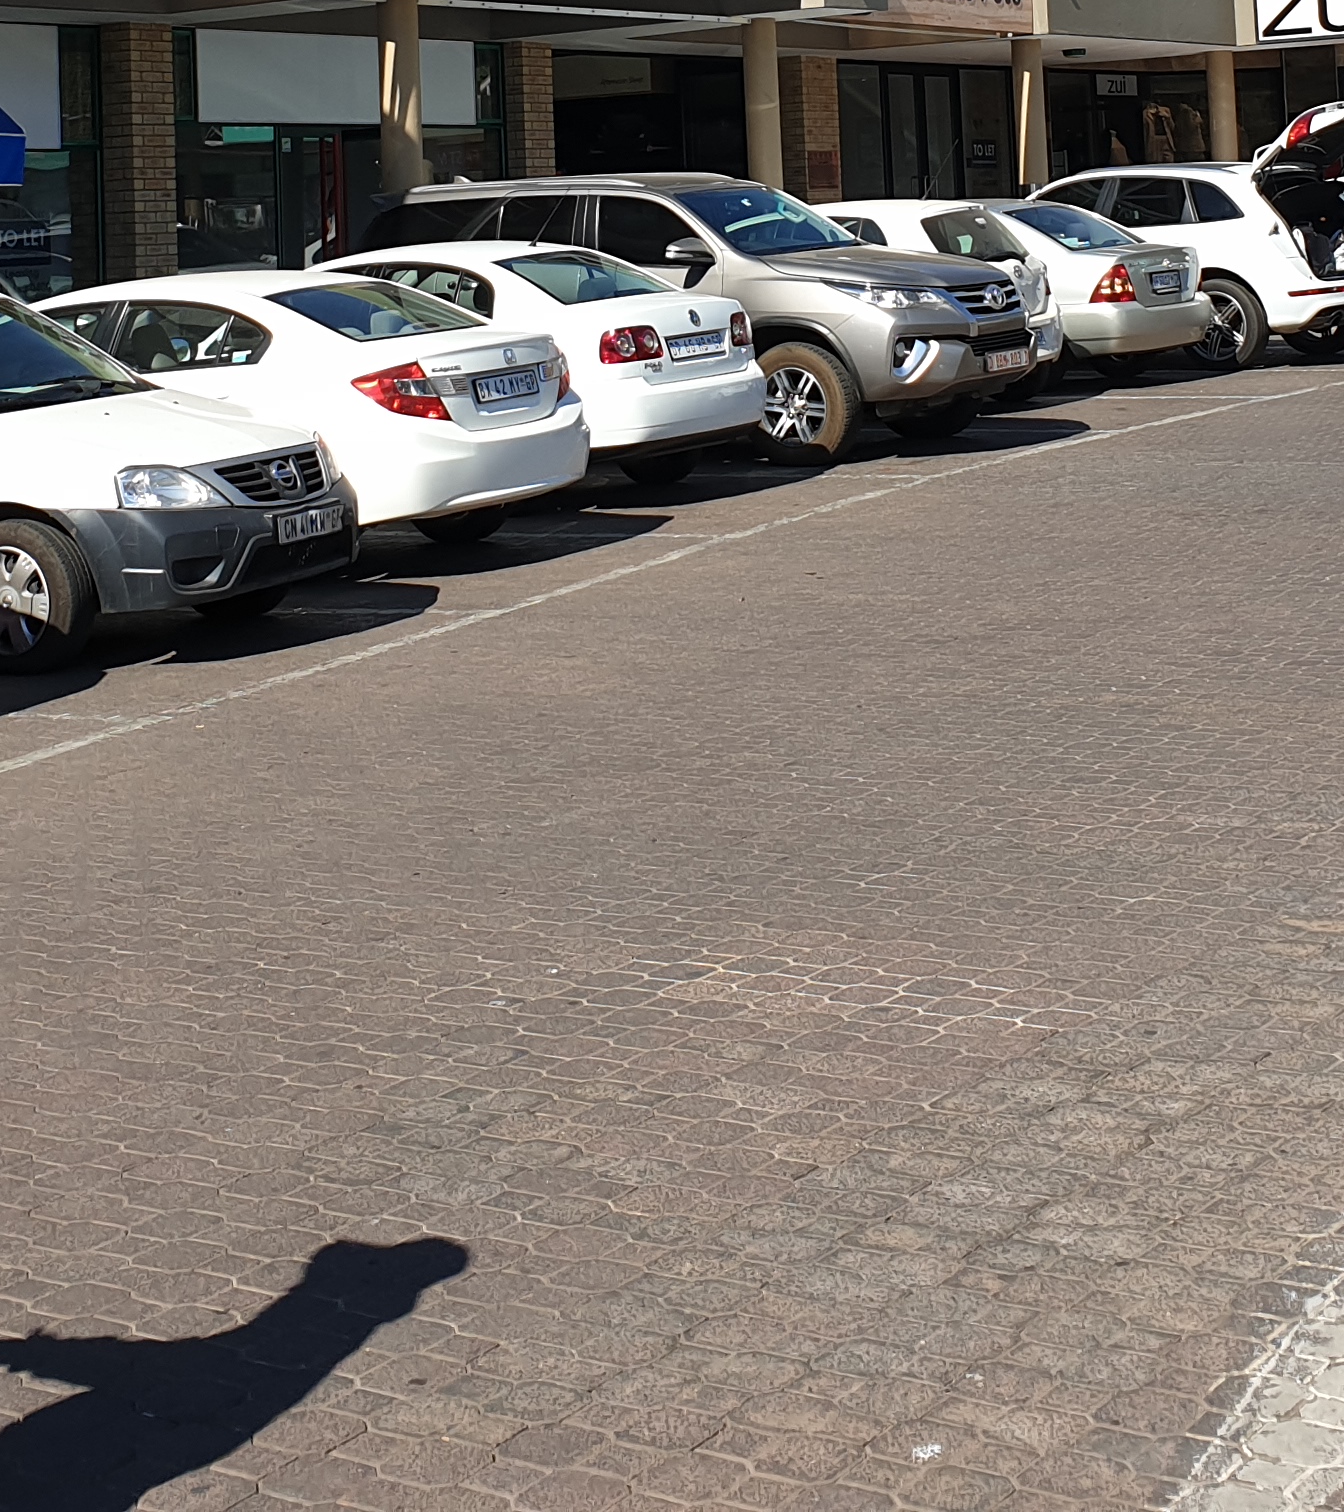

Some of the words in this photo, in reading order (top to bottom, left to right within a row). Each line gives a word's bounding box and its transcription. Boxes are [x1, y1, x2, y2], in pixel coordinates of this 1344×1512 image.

[1107, 75, 1126, 94] zui
[973, 144, 983, 156] TO
[985, 144, 995, 156] LET
[23, 228, 46, 246] LET
[524, 374, 535, 390] GP
